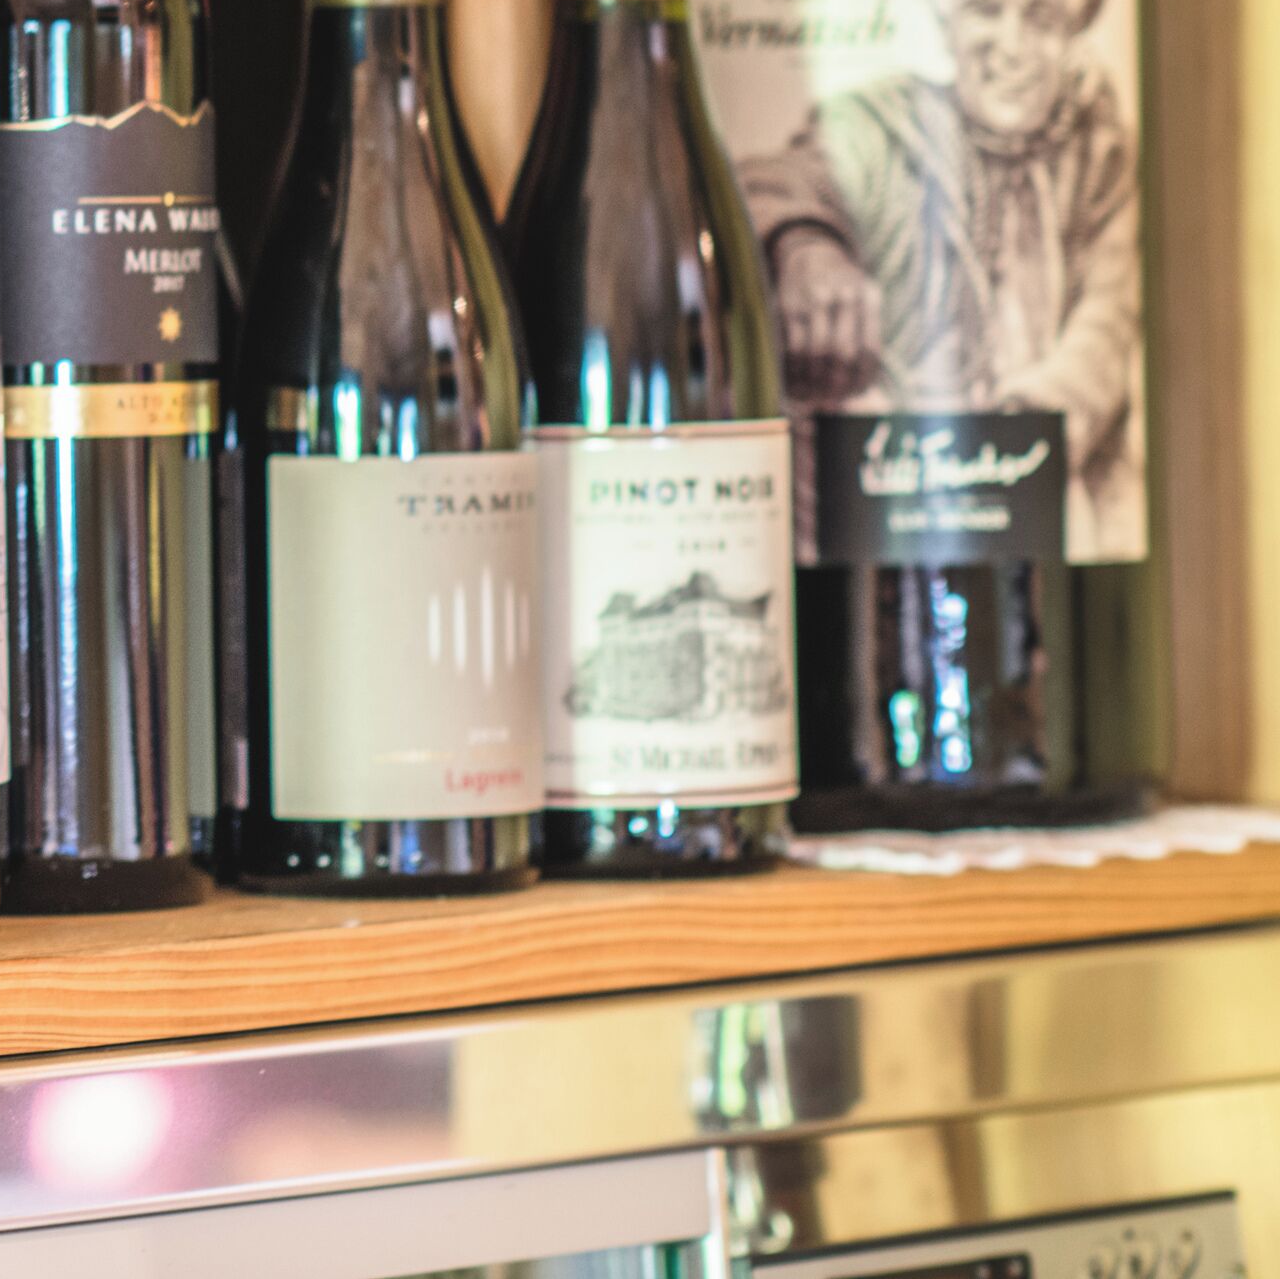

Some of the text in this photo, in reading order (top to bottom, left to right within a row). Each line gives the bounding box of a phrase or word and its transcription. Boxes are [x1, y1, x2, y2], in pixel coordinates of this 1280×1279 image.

[52, 208, 158, 235] ELENA
[124, 247, 203, 275] MERLOT
[589, 477, 699, 506] PINOT
